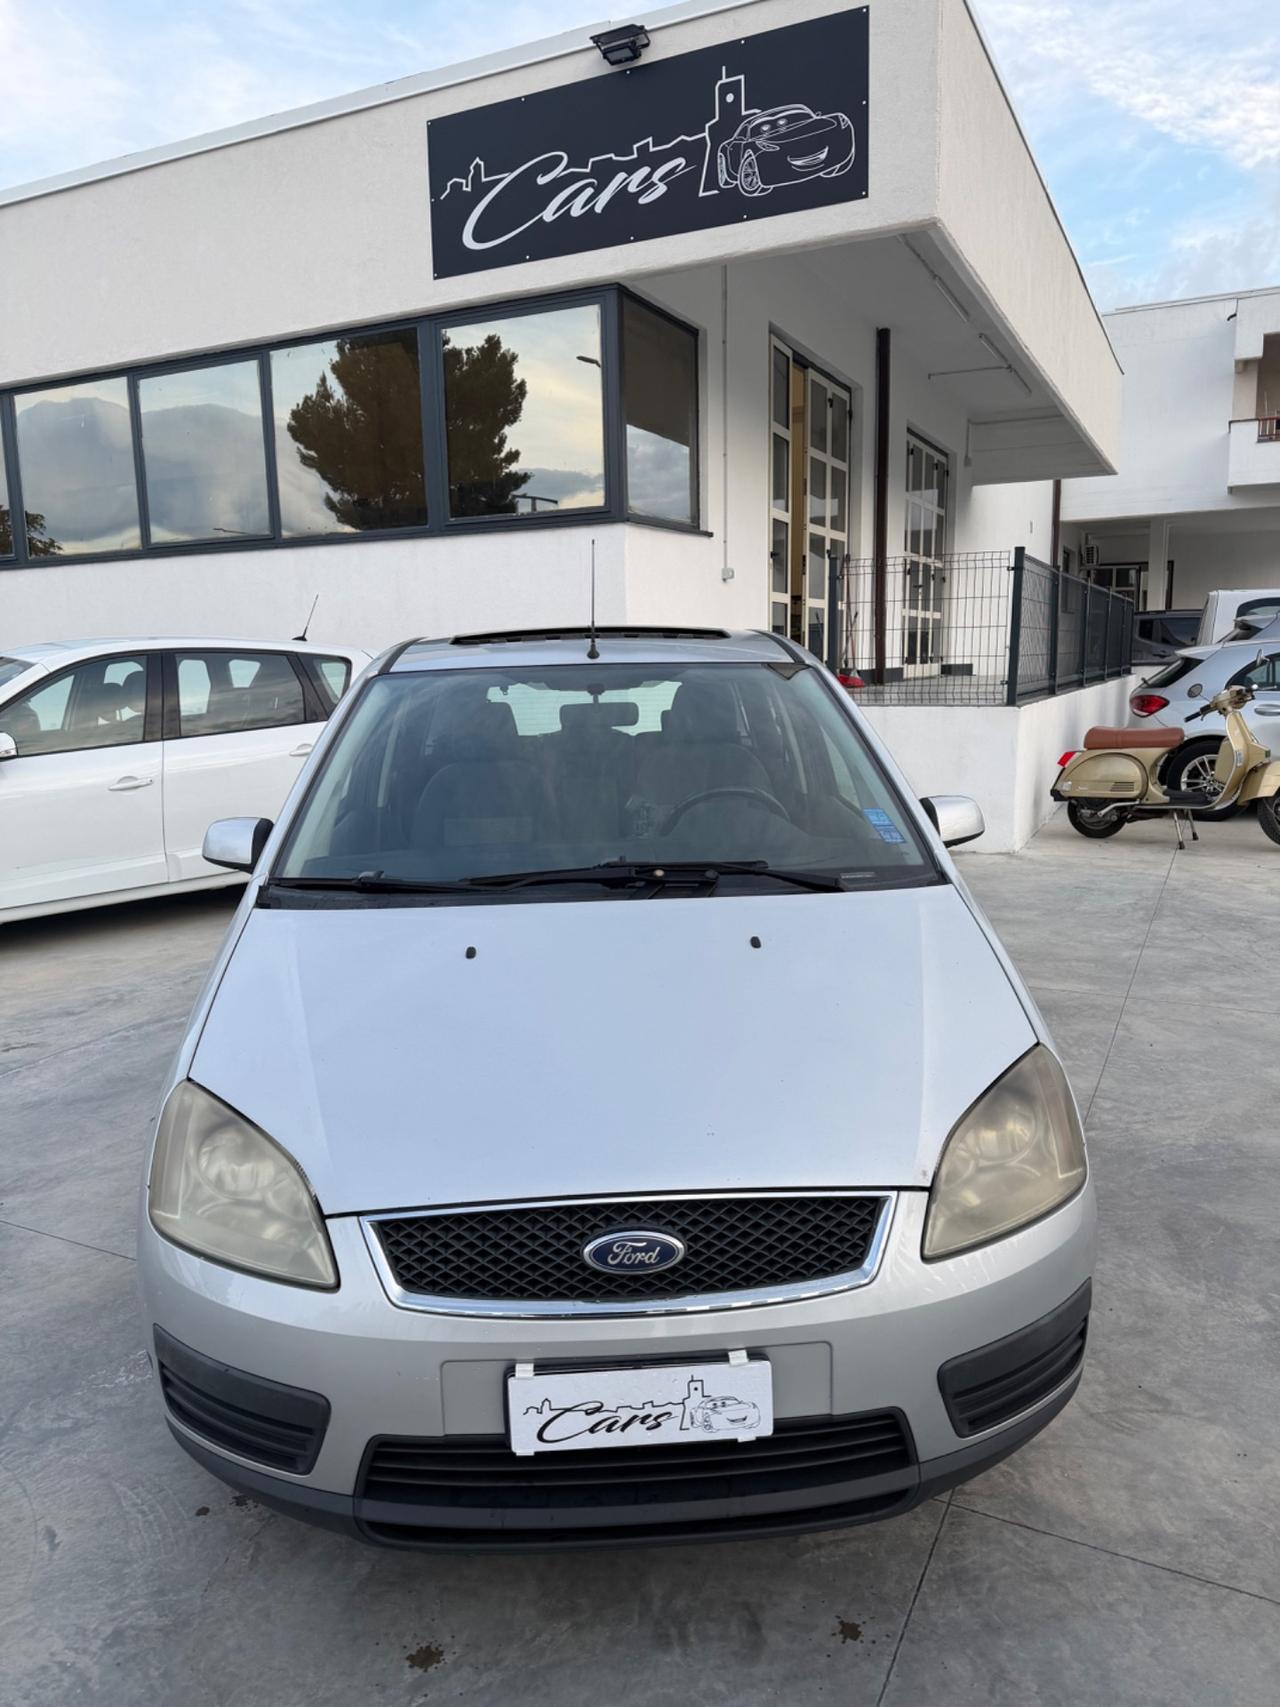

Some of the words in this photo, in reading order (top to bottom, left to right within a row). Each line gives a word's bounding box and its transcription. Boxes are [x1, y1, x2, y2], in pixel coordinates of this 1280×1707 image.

[462, 151, 696, 249] Cars
[607, 1241, 660, 1265] Ford
[536, 1401, 678, 1443] Cars
